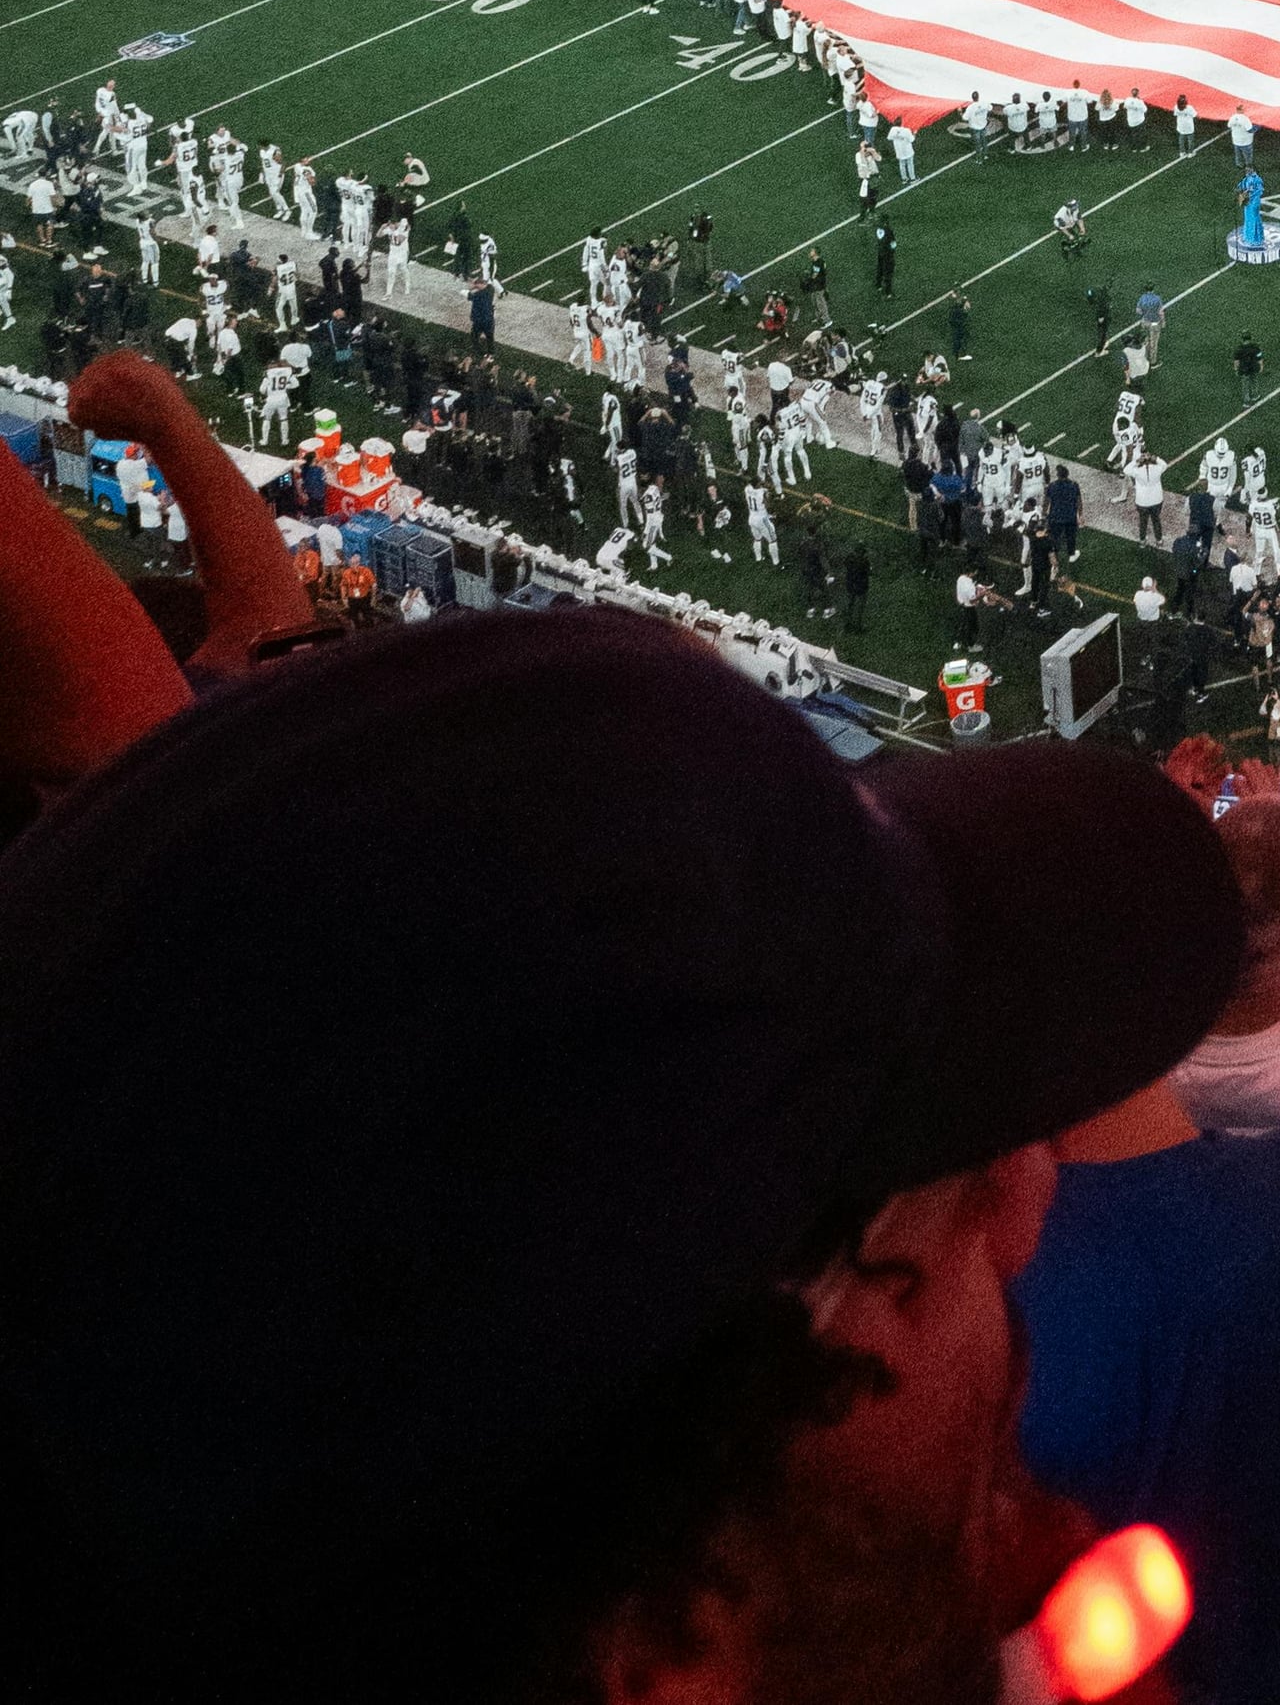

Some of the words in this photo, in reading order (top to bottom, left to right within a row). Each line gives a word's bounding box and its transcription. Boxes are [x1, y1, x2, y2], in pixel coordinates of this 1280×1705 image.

[677, 39, 797, 82] 40
[786, 413, 801, 430] 13
[1024, 464, 1043, 480] 58
[1210, 466, 1229, 480] 93
[956, 690, 976, 711] G
